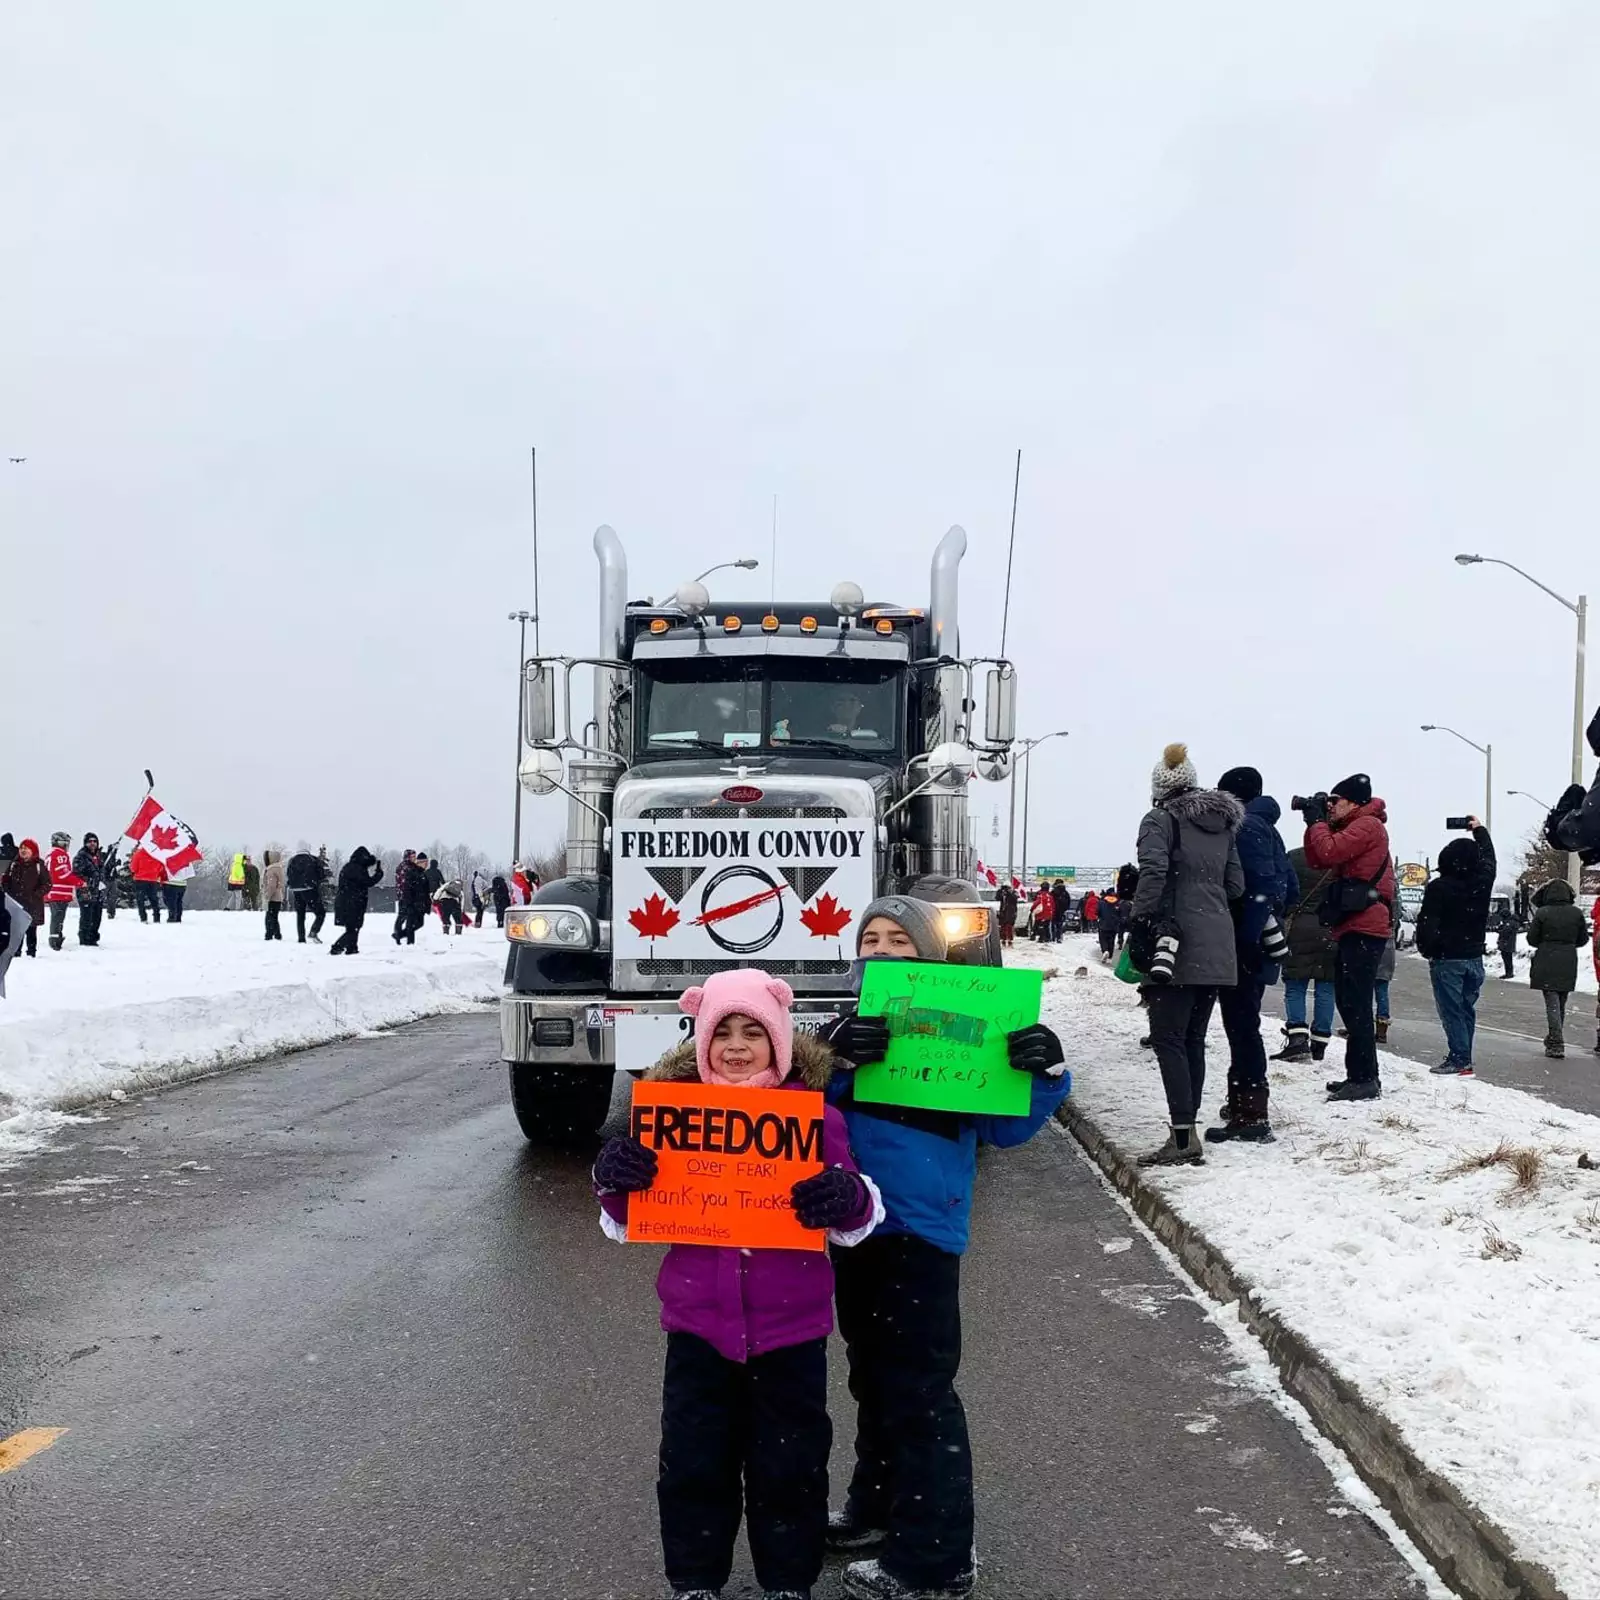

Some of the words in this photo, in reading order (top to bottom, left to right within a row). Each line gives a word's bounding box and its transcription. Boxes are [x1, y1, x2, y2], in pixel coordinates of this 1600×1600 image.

[620, 830, 750, 858] FREEDOM
[757, 830, 866, 858] CONVOY
[632, 1105, 824, 1163] FREEDOM
[736, 1161, 778, 1181] FEAR!
[637, 1220, 732, 1240] #endmandates
